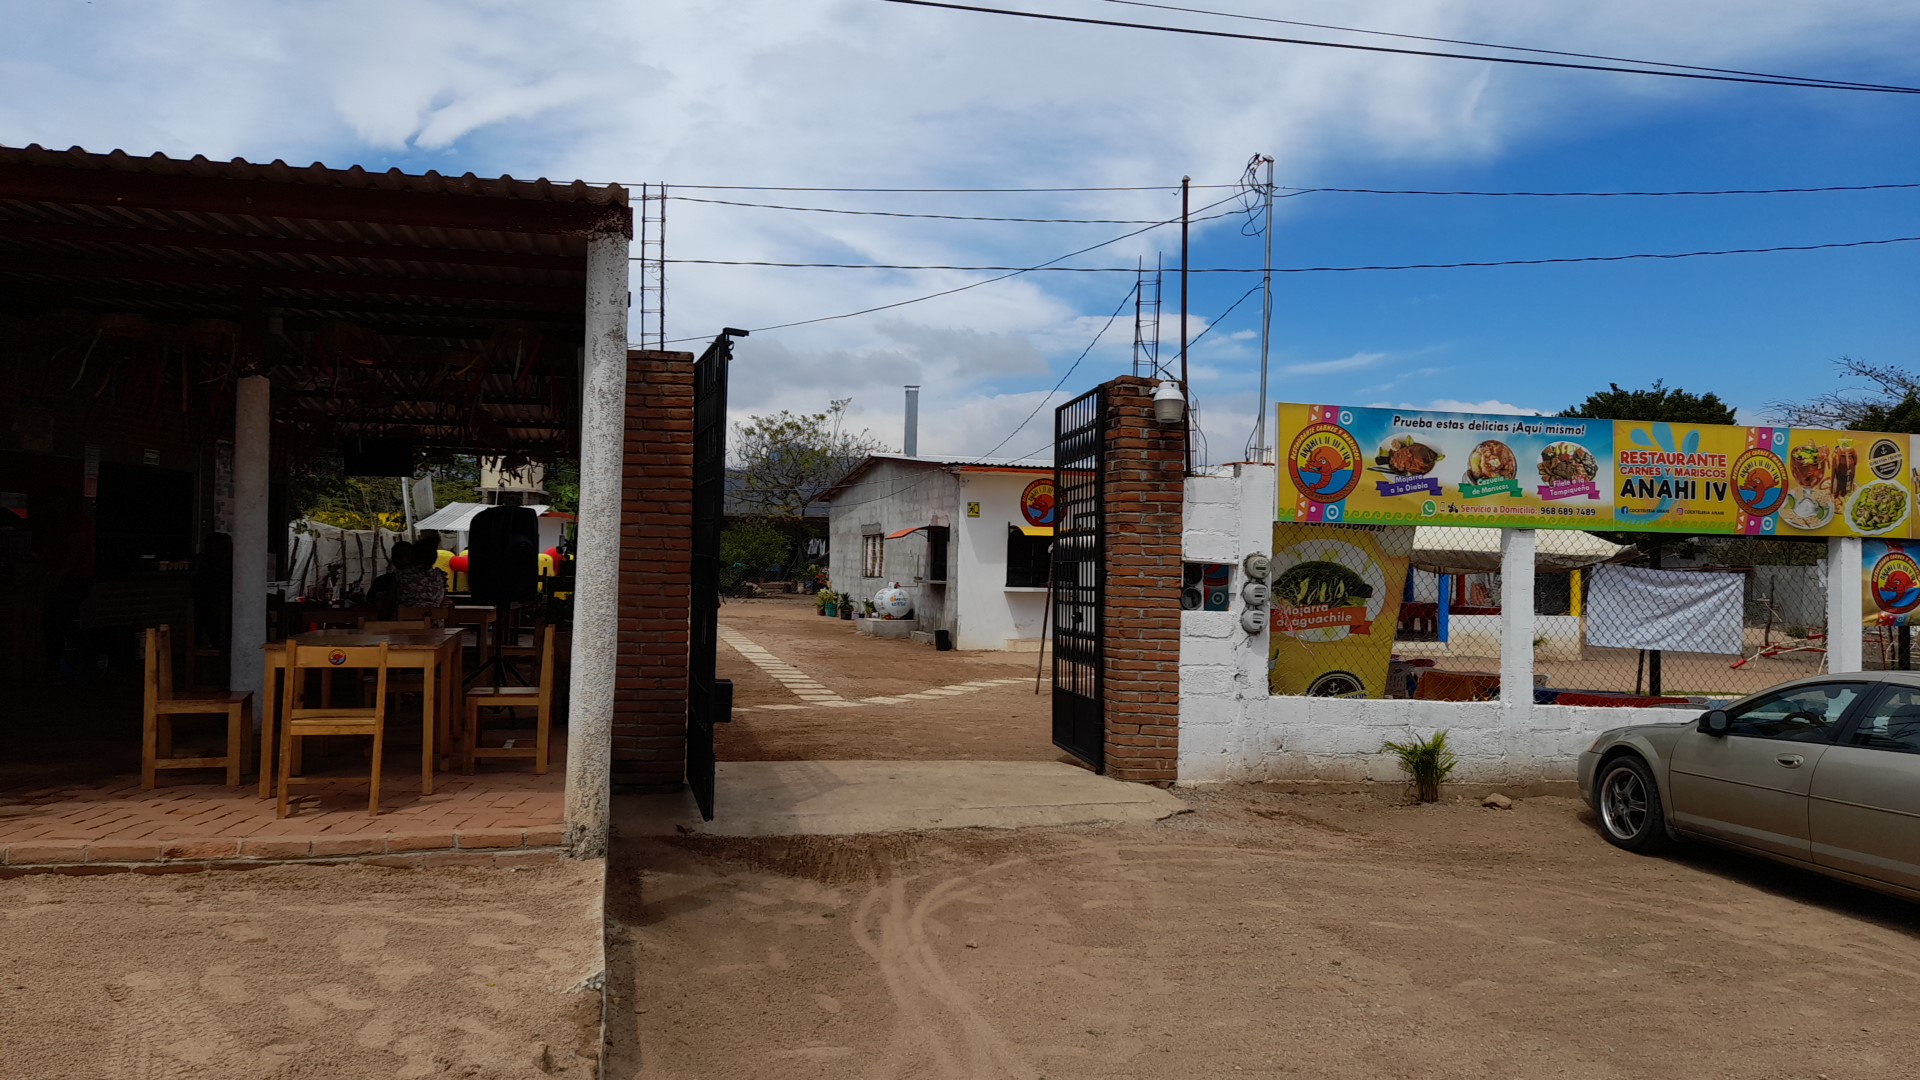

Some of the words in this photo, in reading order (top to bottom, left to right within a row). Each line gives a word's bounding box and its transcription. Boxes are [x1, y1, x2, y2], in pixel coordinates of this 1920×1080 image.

[1393, 416, 1432, 428] Prueba
[1436, 420, 1464, 429] estas
[1468, 420, 1509, 431] delicias
[1512, 422, 1542, 435] ¡Aquí
[1545, 424, 1585, 435] mismo!
[1300, 438, 1318, 458] ANAHI
[1620, 452, 1727, 467] RESTAURANTE
[1620, 467, 1661, 476] CARNES
[1665, 468, 1671, 476] Y
[1674, 468, 1727, 478] MARISCOS
[1395, 475, 1423, 483] Mojarra
[1477, 476, 1504, 485] Cazuela
[1405, 482, 1428, 491] Diabla
[1481, 484, 1509, 493] Mariscos
[1550, 484, 1590, 496] Tampiqueña
[1620, 479, 1696, 499] ANAHI
[1705, 481, 1727, 501] IV
[1461, 505, 1491, 513] Servicio
[1500, 506, 1537, 514] Domicilio:
[1540, 507, 1555, 515] 968
[1558, 507, 1573, 515] 689
[1576, 508, 1596, 516] 7489
[1292, 611, 1352, 628] aguachile
